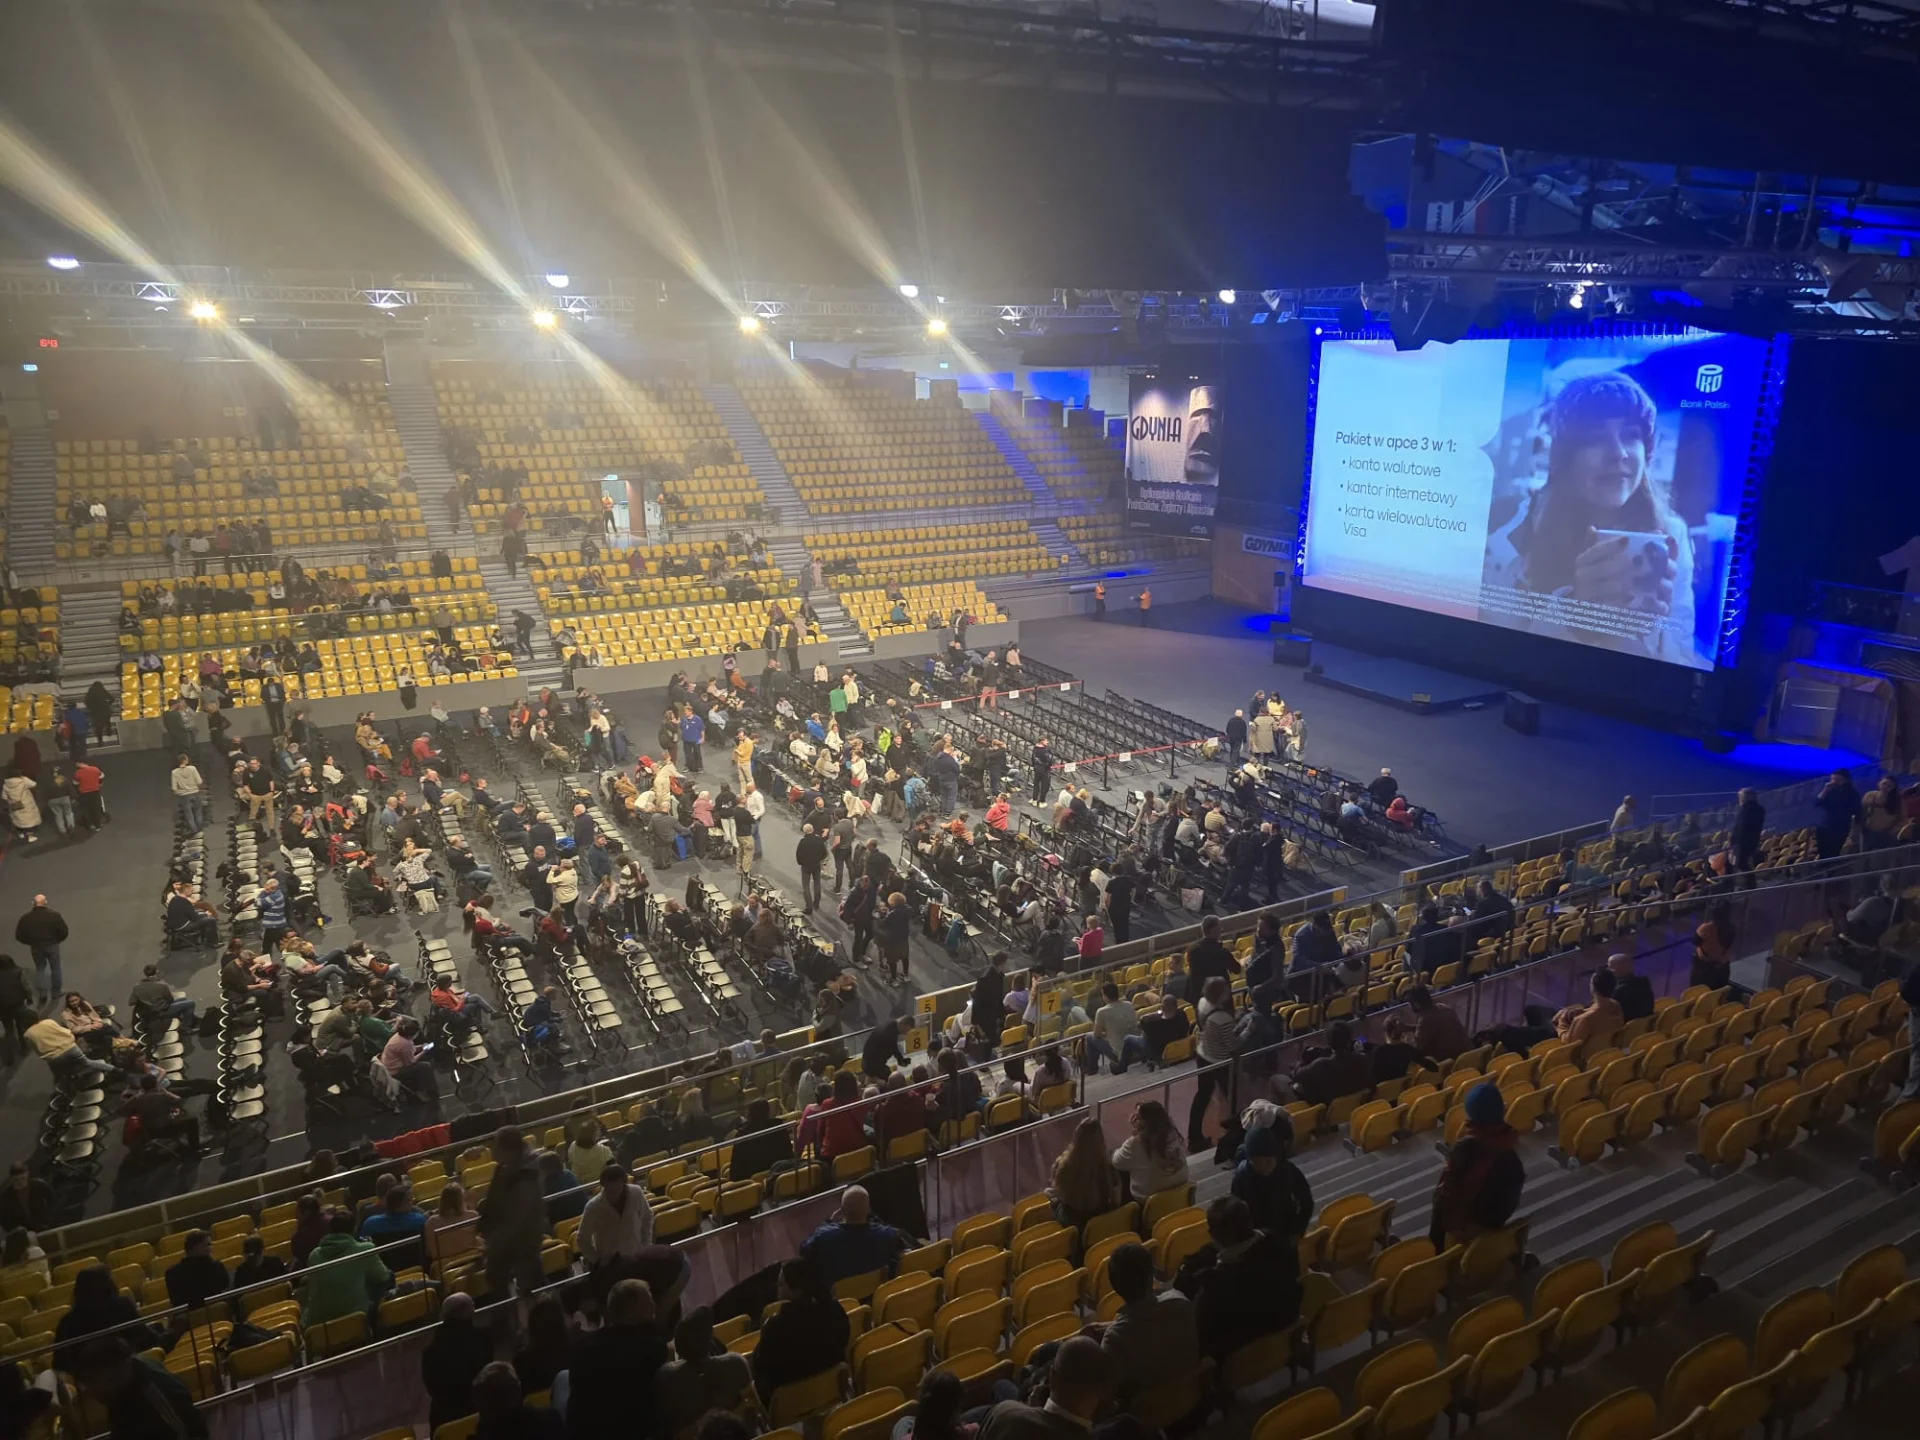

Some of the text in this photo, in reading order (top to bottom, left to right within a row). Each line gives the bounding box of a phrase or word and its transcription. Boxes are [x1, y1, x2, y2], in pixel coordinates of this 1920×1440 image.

[1680, 399, 1731, 409] Bank Polski
[1131, 415, 1182, 443] GDYNIA
[1335, 431, 1457, 453] Pakiet w apce 3 w 1:
[1348, 456, 1442, 478] konto walutowe
[1346, 480, 1458, 508] kantor internetowy
[1344, 504, 1467, 532] karta wielowalutowa
[1343, 521, 1367, 538] Visa
[1245, 537, 1290, 554] GDYNIA
[924, 1003, 931, 1013] 5
[1047, 999, 1056, 1012] 7
[913, 1037, 921, 1050] 8
